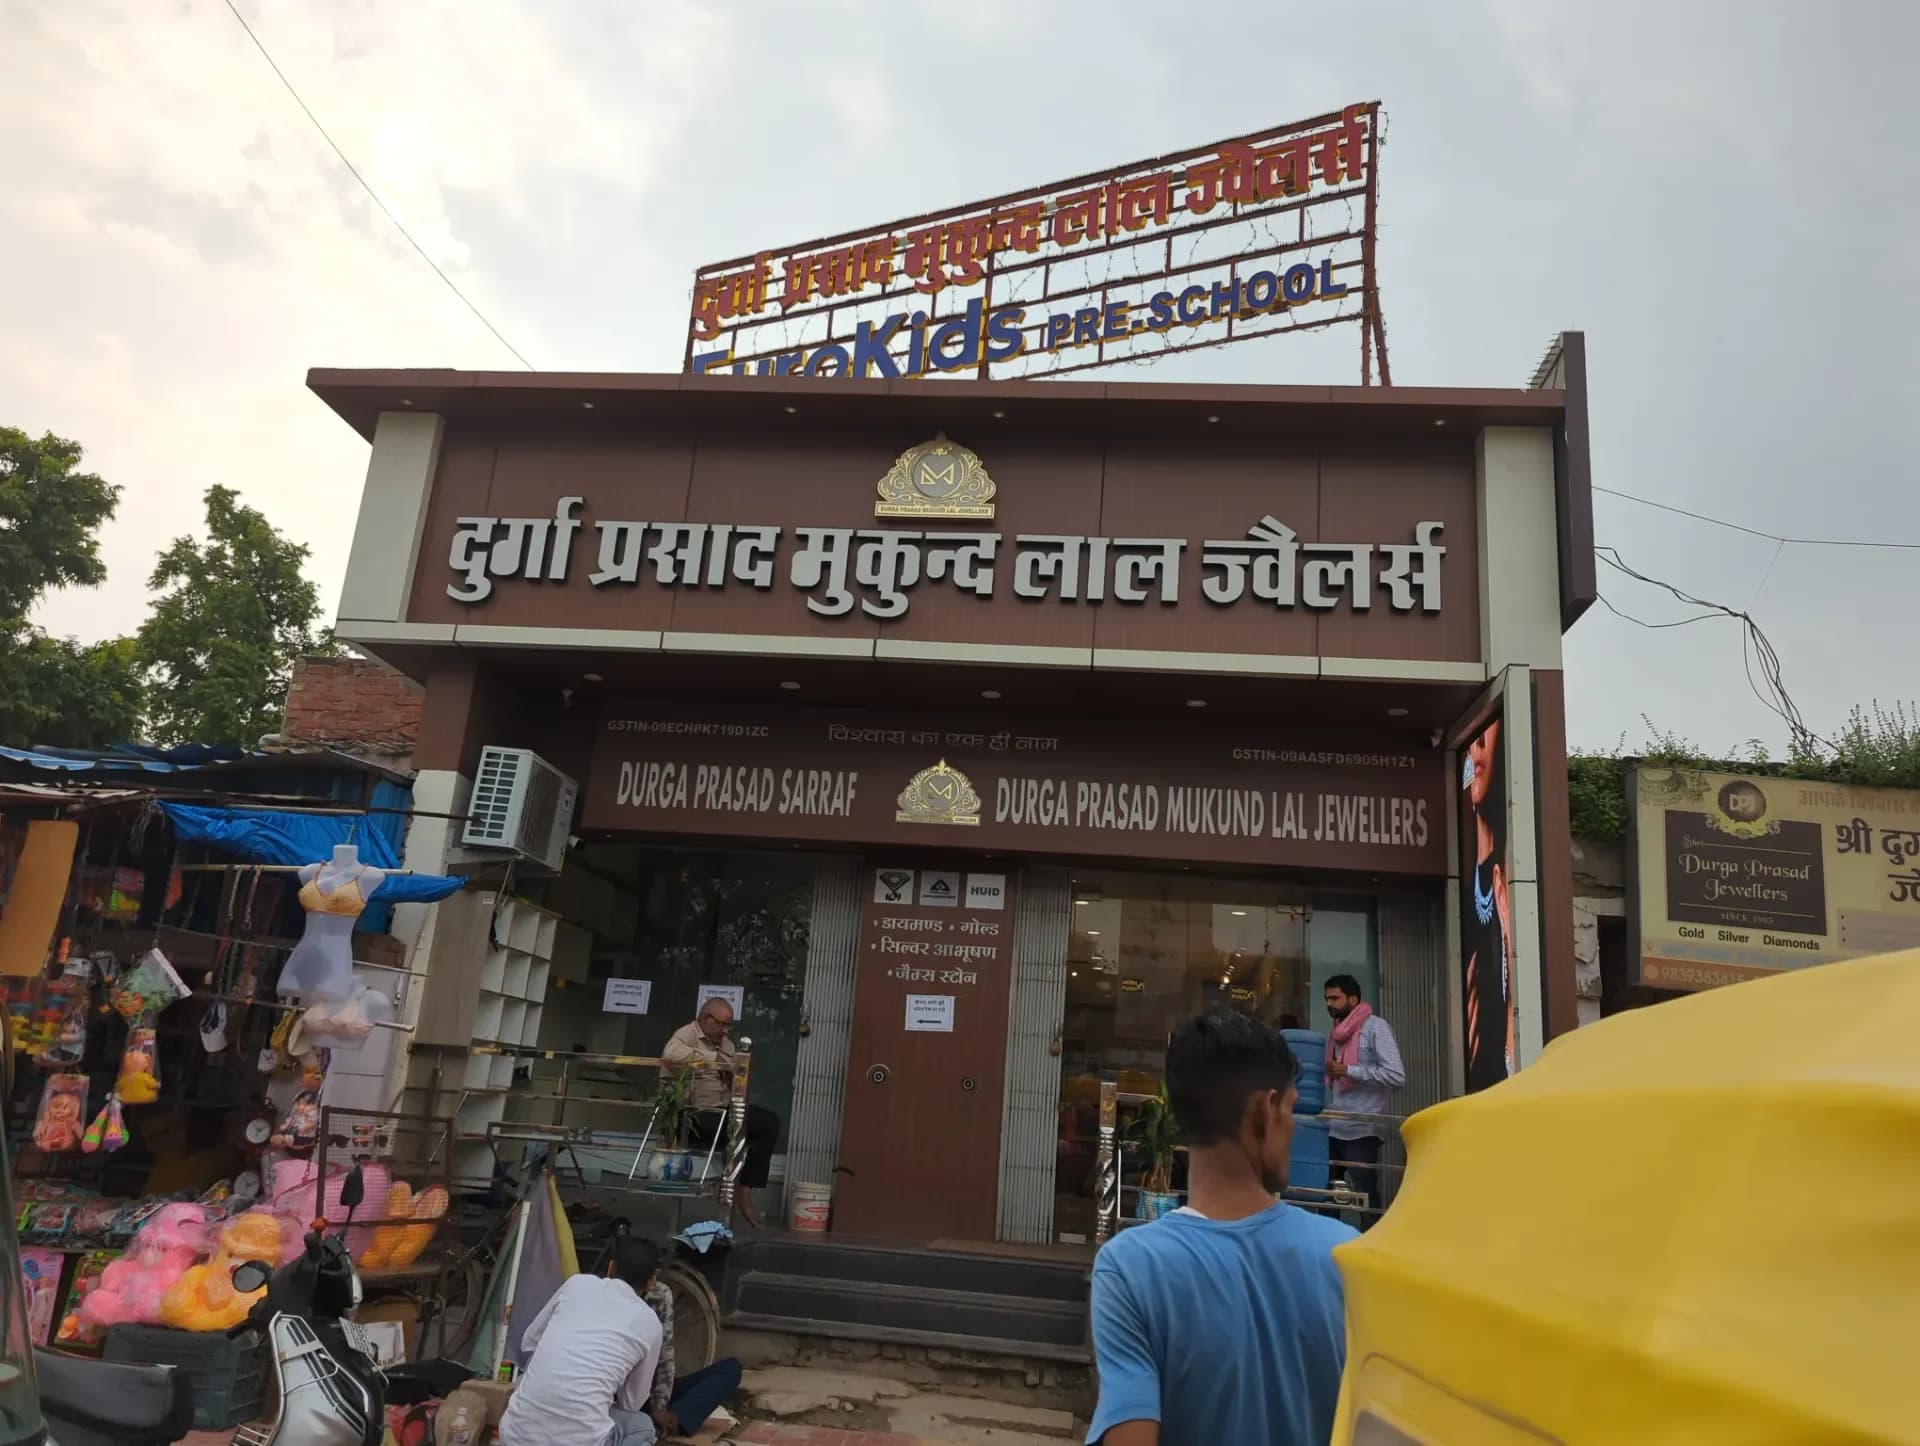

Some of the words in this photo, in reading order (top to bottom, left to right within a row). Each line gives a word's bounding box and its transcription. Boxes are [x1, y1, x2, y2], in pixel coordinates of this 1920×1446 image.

[693, 250, 773, 341] दुर्गा
[780, 236, 897, 310] प्रसाद
[904, 201, 1042, 294] मुकुन्द
[1054, 169, 1173, 247] लाल
[446, 496, 583, 601] दुर्गा
[589, 521, 781, 586] प्रसाद
[790, 527, 1002, 617] मुकुन्द
[1013, 534, 1187, 601] लाल
[1201, 515, 1446, 610] ज्वैलर्स
[828, 724, 905, 744] विश्वास
[912, 731, 939, 745] का
[945, 733, 984, 747] एक
[989, 731, 1011, 751] ही
[1015, 736, 1060, 751] नाम
[617, 761, 688, 808] DURGA
[693, 765, 775, 812] PRASAD
[779, 768, 858, 816] SARRAF
[995, 777, 1069, 826] DURGA
[1076, 782, 1159, 830] PRASAD
[1165, 786, 1264, 837] MUKUND
[1271, 791, 1308, 840] LAL
[1314, 794, 1428, 847] JEWELLERS
[1835, 817, 1873, 855] श्री
[1678, 854, 1738, 879] Durga
[1744, 859, 1812, 881] Prasad
[970, 886, 1000, 897] HUID
[1704, 878, 1789, 901] Jewellers
[881, 917, 943, 932] डायमण्ड
[1720, 912, 1749, 922] SINCE
[880, 935, 930, 955] सिल्वर
[933, 943, 998, 963] आभूषण
[1678, 926, 1704, 939] Gold
[1718, 930, 1749, 944] Silver
[1763, 934, 1821, 951] Diamonds
[939, 967, 978, 985] स्टोन
